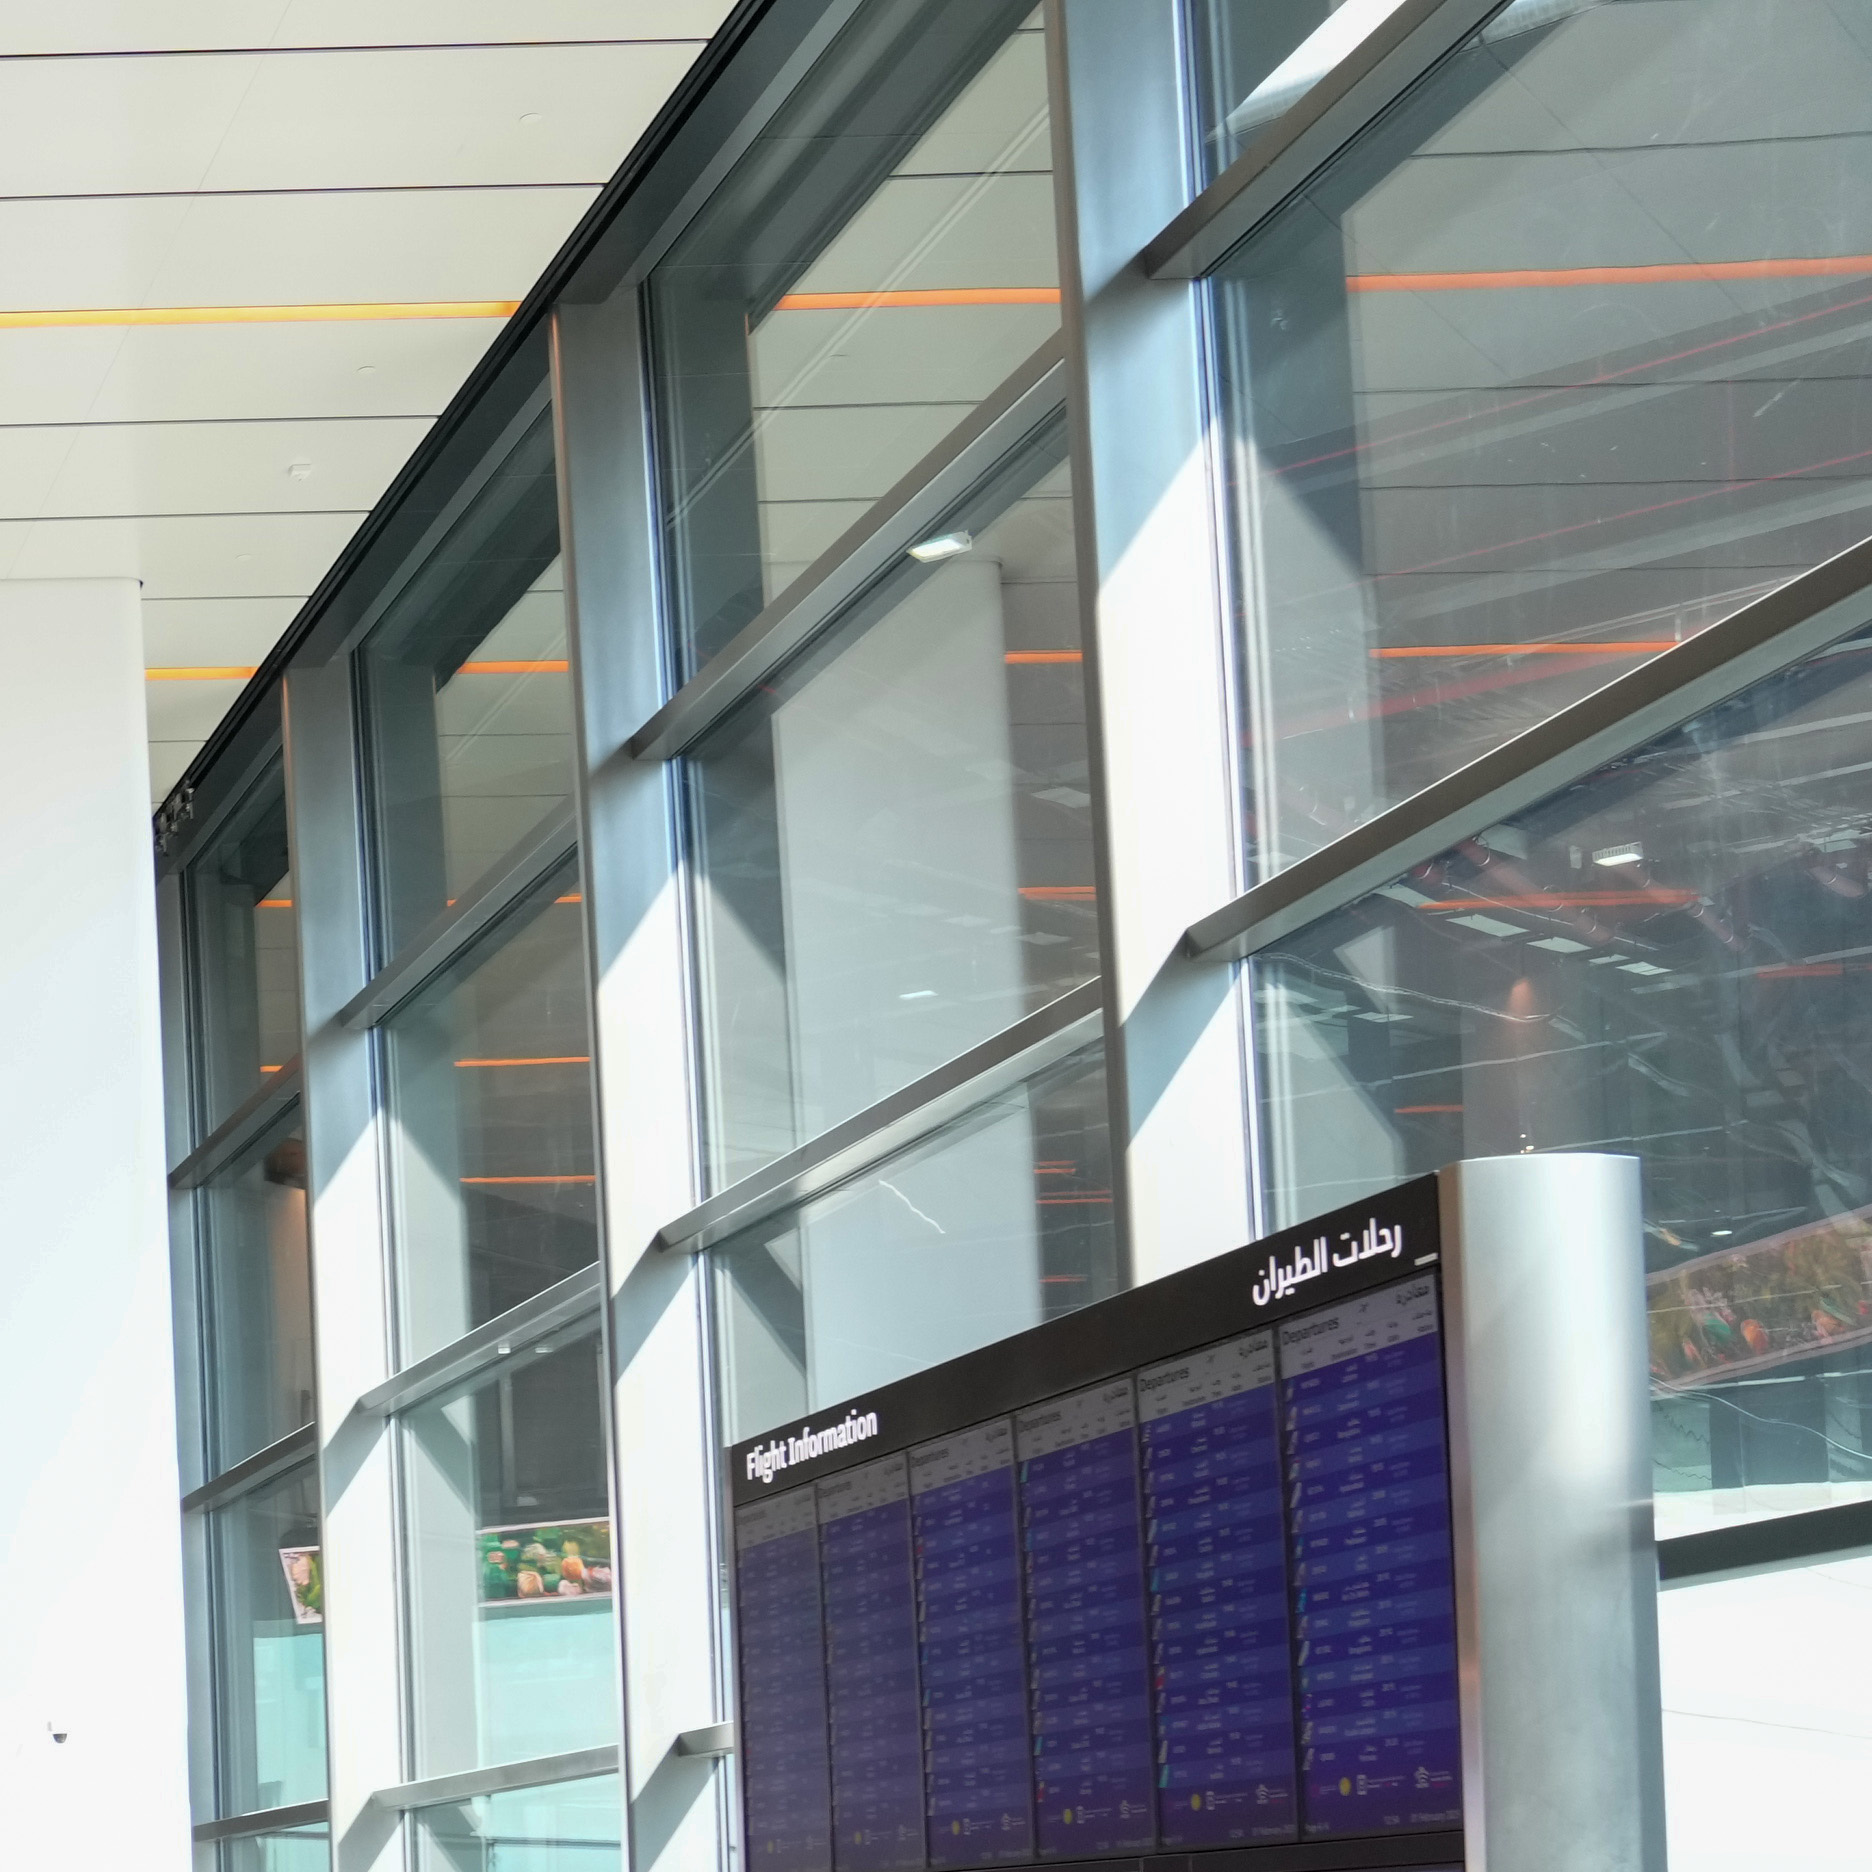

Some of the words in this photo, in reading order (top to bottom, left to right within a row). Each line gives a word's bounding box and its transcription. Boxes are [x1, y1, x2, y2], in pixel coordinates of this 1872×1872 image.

[1251, 1234, 1330, 1306] الطيران
[1332, 1217, 1402, 1270] رحلات
[746, 1431, 787, 1484] Flight
[788, 1409, 879, 1466] Information
